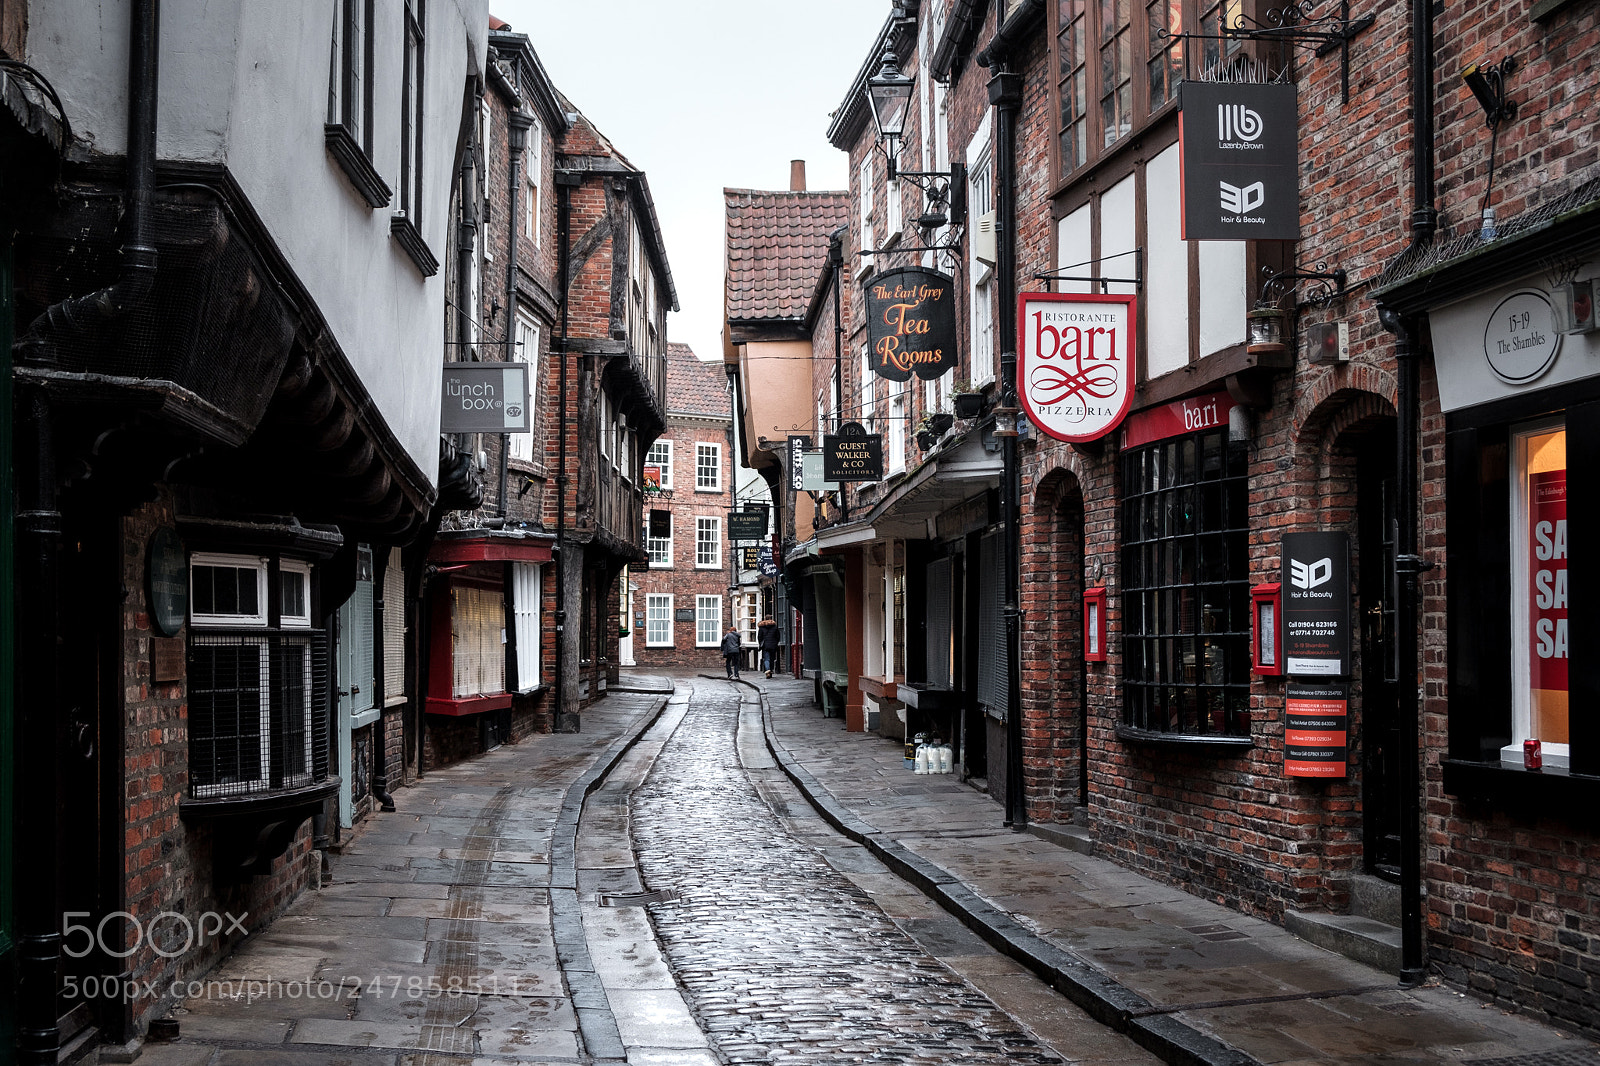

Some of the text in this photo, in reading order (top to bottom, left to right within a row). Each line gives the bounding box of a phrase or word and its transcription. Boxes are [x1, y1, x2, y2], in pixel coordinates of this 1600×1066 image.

[1219, 141, 1264, 151] LazenbyBrown
[1243, 216, 1266, 225] Beauty
[873, 283, 944, 302] The Earl Grey
[884, 299, 931, 336] Tea
[1045, 312, 1116, 323] RISTORANTE
[1032, 310, 1121, 361] bari
[1497, 331, 1546, 354] The Shambles
[876, 335, 942, 372] Rooms
[447, 381, 494, 396] lunch
[1038, 405, 1113, 416] PIZZERIA
[1182, 397, 1219, 430] bari
[838, 442, 868, 450] GUEST
[835, 451, 871, 459] WALKER
[842, 460, 865, 468] & CO
[1309, 591, 1333, 600] Beauty
